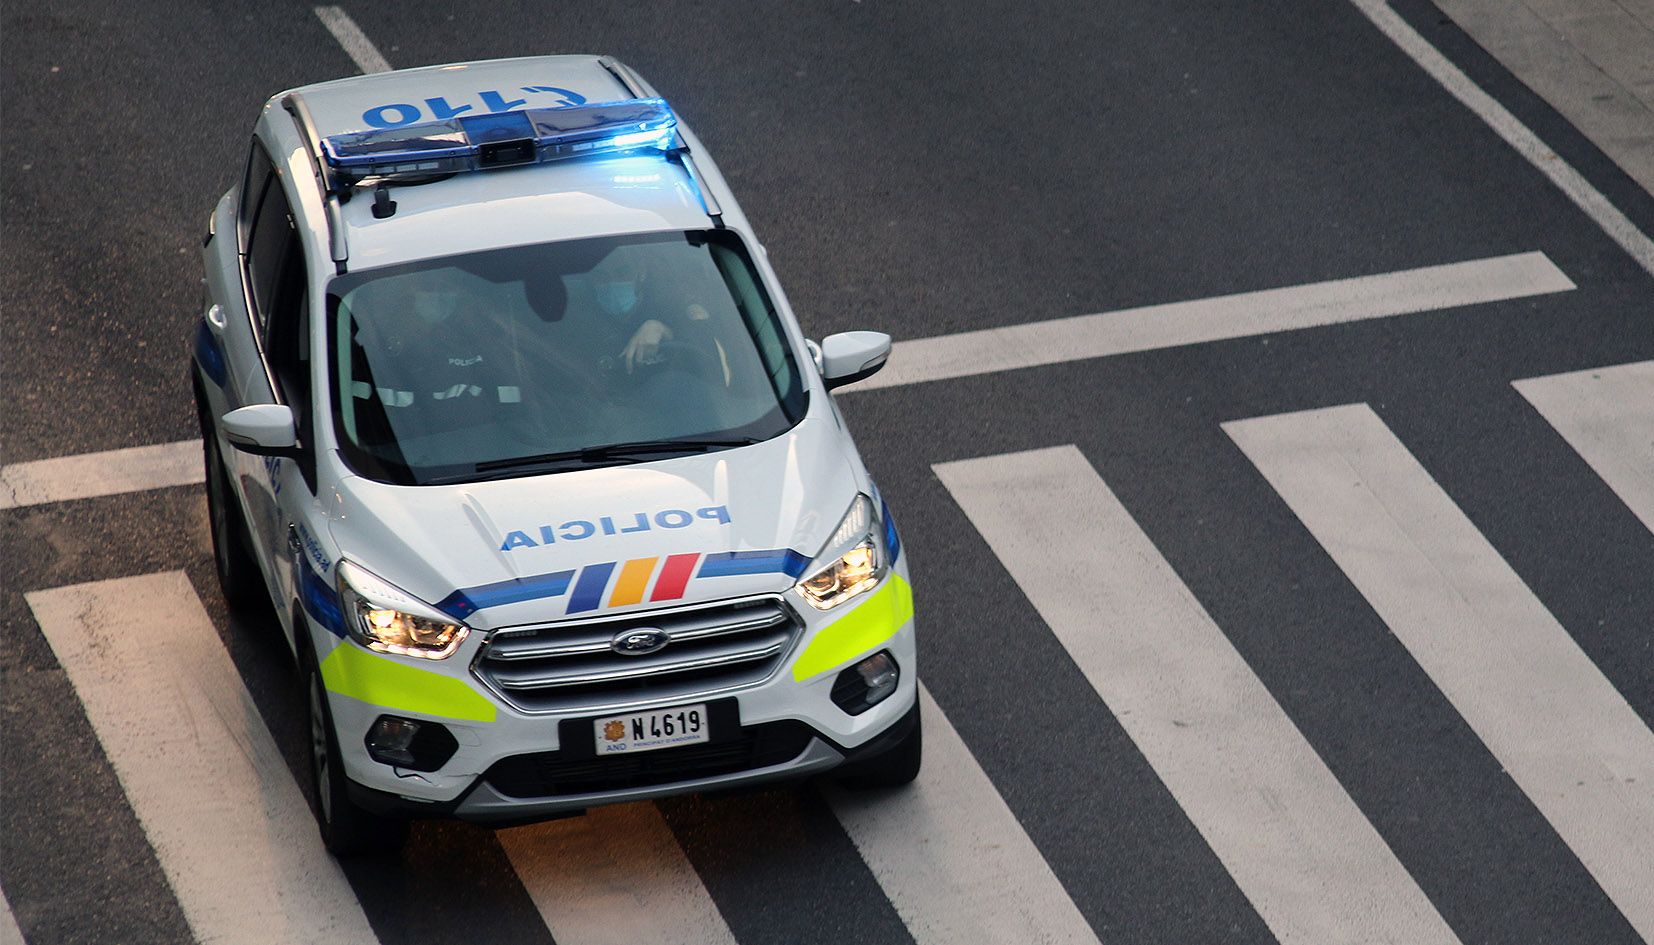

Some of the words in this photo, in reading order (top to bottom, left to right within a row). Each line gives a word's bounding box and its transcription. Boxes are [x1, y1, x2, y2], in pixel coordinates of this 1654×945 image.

[362, 91, 526, 129] 110
[631, 717, 644, 740] N
[650, 710, 700, 738] 4619
[606, 743, 628, 752] AND
